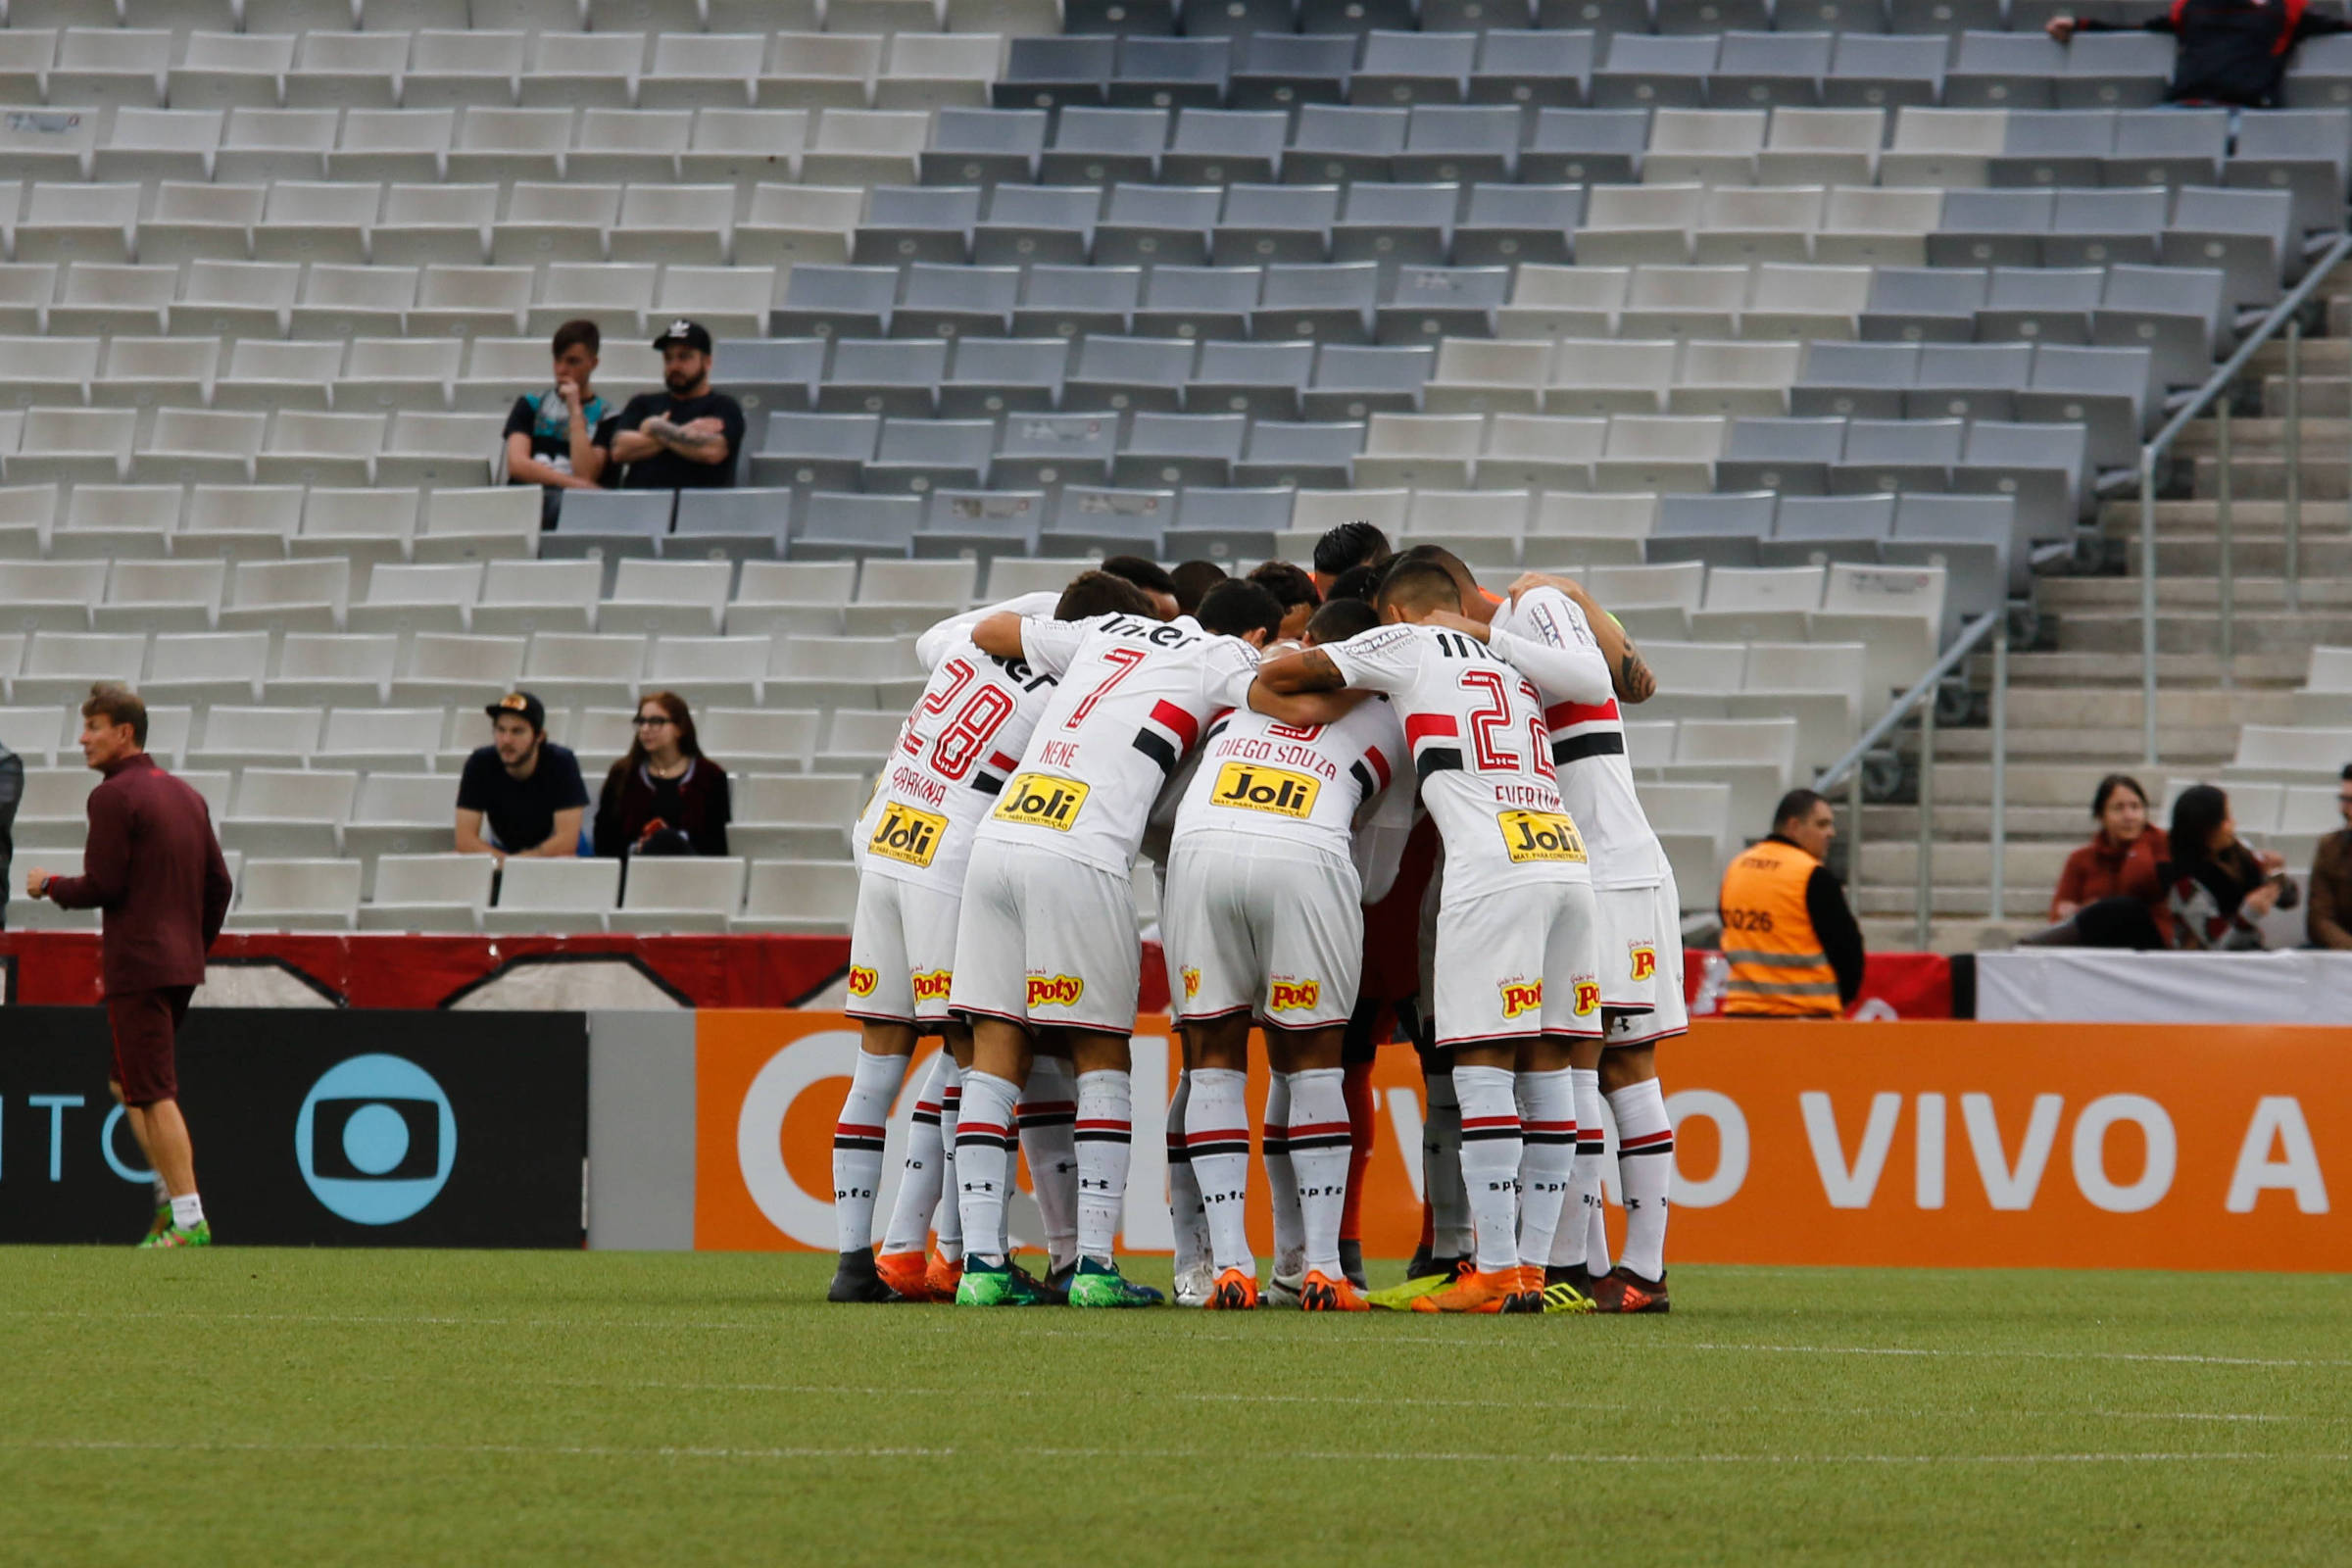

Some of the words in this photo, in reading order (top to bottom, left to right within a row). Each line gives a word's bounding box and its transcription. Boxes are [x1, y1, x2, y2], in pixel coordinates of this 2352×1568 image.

[1062, 647, 1149, 730] 7
[902, 658, 1015, 782] 28
[1458, 669, 1558, 782] 22
[1039, 740, 1079, 768] NENE
[1215, 738, 1272, 760] DIEGO
[1274, 745, 1337, 781] SOUZA
[1004, 783, 1075, 820] Joli
[1222, 773, 1307, 809] Joli
[874, 814, 935, 855] Joli
[1517, 822, 1581, 852] Joli
[1027, 979, 1079, 1004] Poty
[1272, 983, 1318, 1008] Poty
[0, 1095, 160, 1185] TO
[1799, 1091, 2178, 1213] VIVO
[2225, 1096, 2330, 1214] A
[1299, 1185, 1344, 1197] spfc
